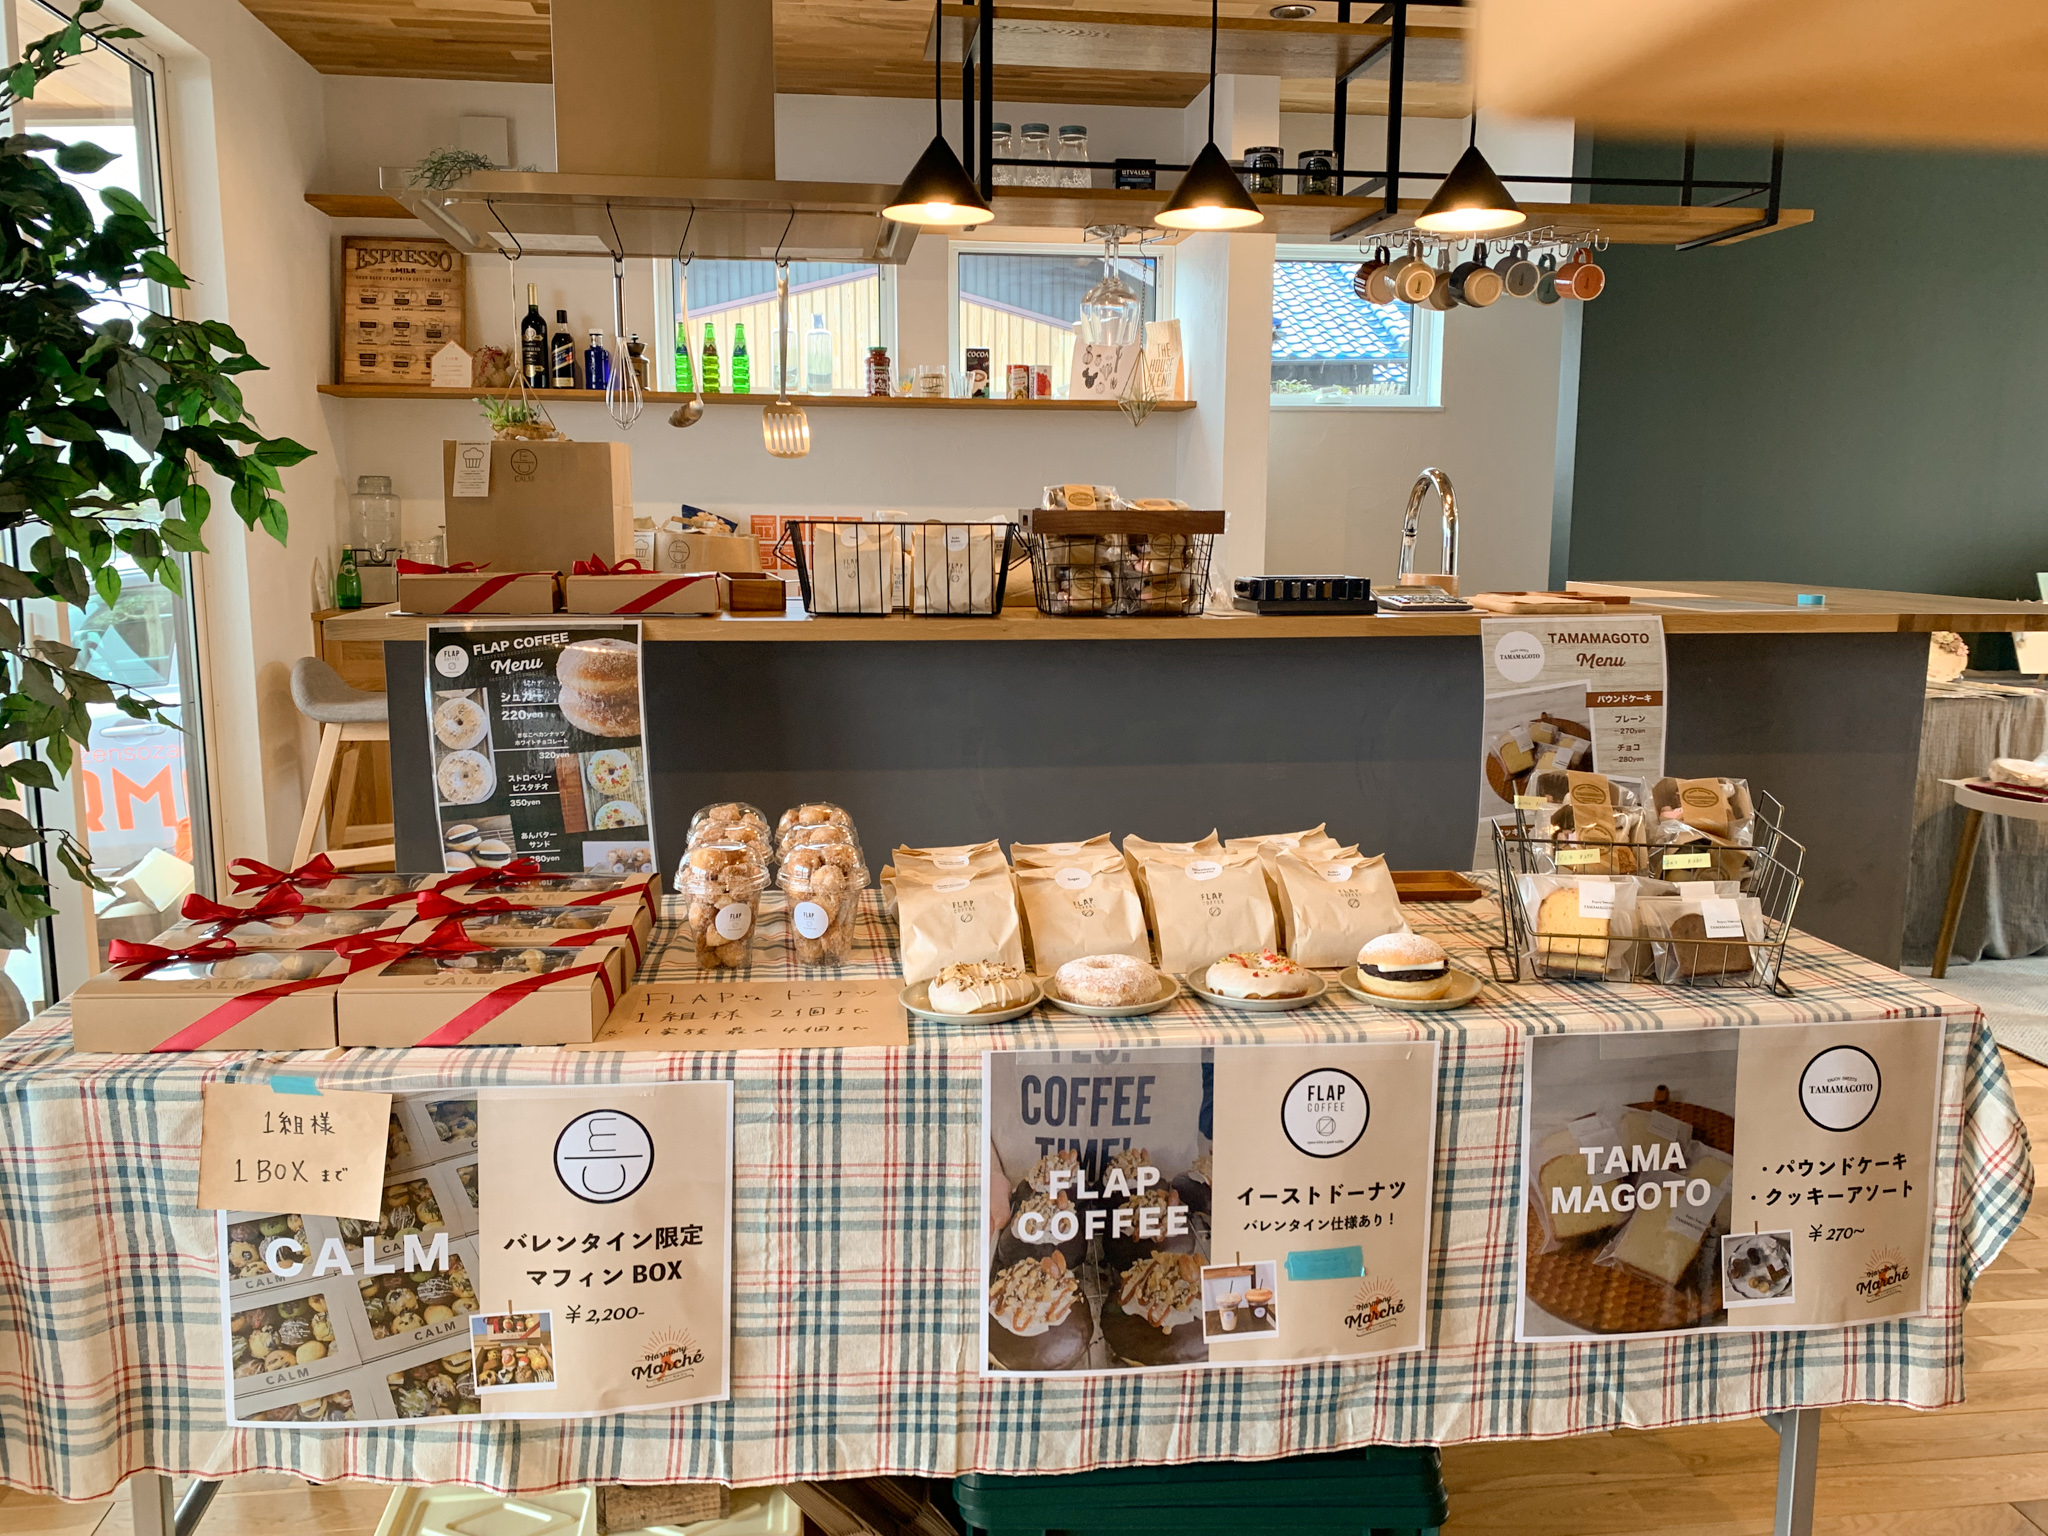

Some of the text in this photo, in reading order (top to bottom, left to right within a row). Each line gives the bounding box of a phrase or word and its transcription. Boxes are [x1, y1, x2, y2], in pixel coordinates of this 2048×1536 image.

[355, 248, 452, 272] ESPRESSO
[1157, 343, 1170, 358] THE
[1150, 358, 1174, 373] HOUSE
[1147, 373, 1172, 388] BLEND
[473, 632, 569, 656] FLAP COFFEE
[1548, 633, 1649, 644] TAMAMAGOTO
[490, 657, 544, 676] Menu
[1576, 653, 1626, 669] Menu
[1597, 694, 1652, 704] パウンドケーキ
[501, 709, 544, 721] 220yen
[1614, 715, 1646, 723] プレーン
[1617, 743, 1640, 751] チョコ
[539, 751, 569, 760] 320yen
[510, 798, 541, 808] 350yen
[521, 830, 557, 840] あんバター
[529, 840, 551, 849] サンド
[952, 899, 974, 909] FLAP
[1201, 892, 1223, 901] FLAP
[729, 912, 742, 920] FLAP
[479, 930, 546, 938] CALM
[178, 980, 255, 990] CALM
[423, 977, 497, 986] CALM
[1307, 1084, 1346, 1101] FLAP
[1809, 1083, 1873, 1094] TAMAMAGOTO
[1021, 1074, 1156, 1127] COFFEE
[1307, 1101, 1345, 1113] COFFEE
[1579, 1141, 1688, 1176] TAMA
[1049, 1166, 1161, 1200] FLAP
[1237, 1180, 1406, 1206] イーストドーナツ
[1551, 1178, 1712, 1215] MAGOTO
[1017, 1205, 1190, 1242] COFFEE
[503, 1223, 704, 1254] バレンタイン限定
[265, 1232, 449, 1277] CALM
[1856, 1266, 1910, 1295] Marché
[1344, 1299, 1406, 1329] Marché
[414, 1320, 456, 1341] CALM
[631, 1349, 705, 1381] Marché
[265, 1367, 310, 1385] CALM
